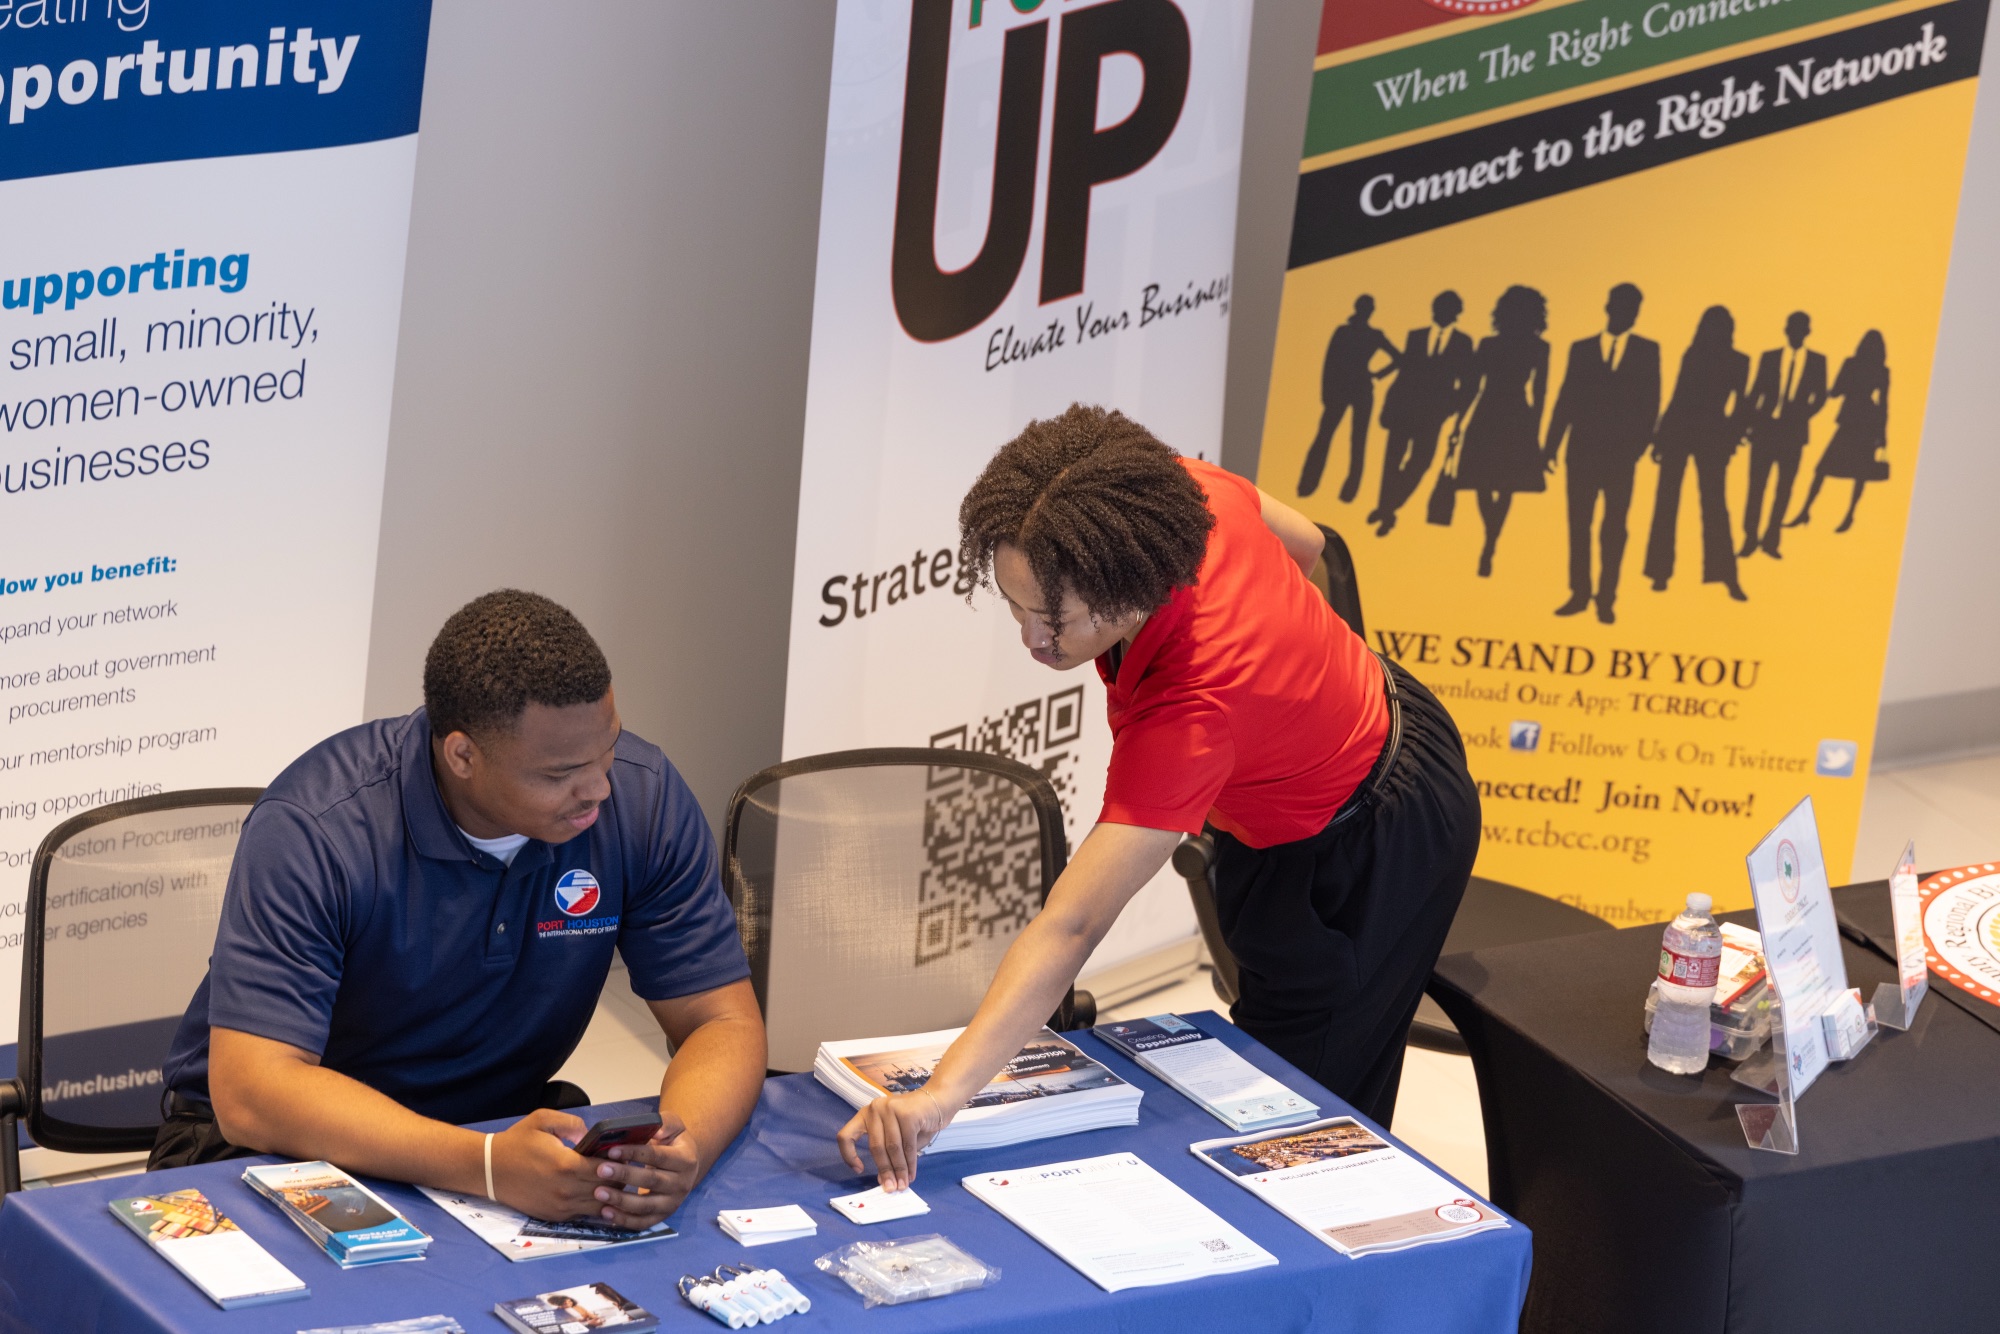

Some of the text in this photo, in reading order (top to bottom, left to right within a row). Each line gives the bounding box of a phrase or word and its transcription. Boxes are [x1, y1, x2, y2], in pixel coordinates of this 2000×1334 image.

[0, 27, 361, 125] portunity
[1373, 67, 1469, 111] When
[1478, 44, 1536, 84] The
[1547, 16, 1633, 67] Right
[1359, 21, 1947, 217] Connect to the Right Network
[891, 0, 1192, 344] UP
[2, 248, 250, 315] upporting
[10, 301, 318, 370] small, minority,
[984, 319, 1065, 372] Elevate
[1076, 302, 1131, 344] Your
[0, 358, 306, 432] women-owned
[0, 439, 210, 494] usinesses
[44, 571, 83, 592] you
[91, 556, 177, 582] benefit:
[57, 612, 98, 636] your
[103, 599, 178, 625] network
[46, 659, 99, 683] about
[105, 644, 216, 679] government
[1374, 630, 1761, 690] WE STAND BY YOU
[9, 687, 136, 724] procurements
[1427, 680, 1739, 721] wnload Our App: TCRBCC
[30, 736, 132, 766] mentorship
[138, 726, 217, 754] program
[1548, 732, 1628, 759] Follow
[1637, 738, 1667, 763] Us
[1675, 741, 1715, 767] On
[1722, 746, 1809, 773] Twitter
[43, 782, 162, 815] opportunities
[1475, 777, 1756, 818] nected! Join Now!
[123, 818, 243, 848] Procurement
[1482, 820, 1651, 864] w.tcbcc.org
[0, 902, 27, 917] you
[170, 872, 208, 892] with
[66, 911, 148, 940] agencies
[537, 915, 619, 932] PORT HOUSTON
[1135, 1033, 1202, 1049] Opportunity
[1321, 1158, 1379, 1174] PROCUREMENT
